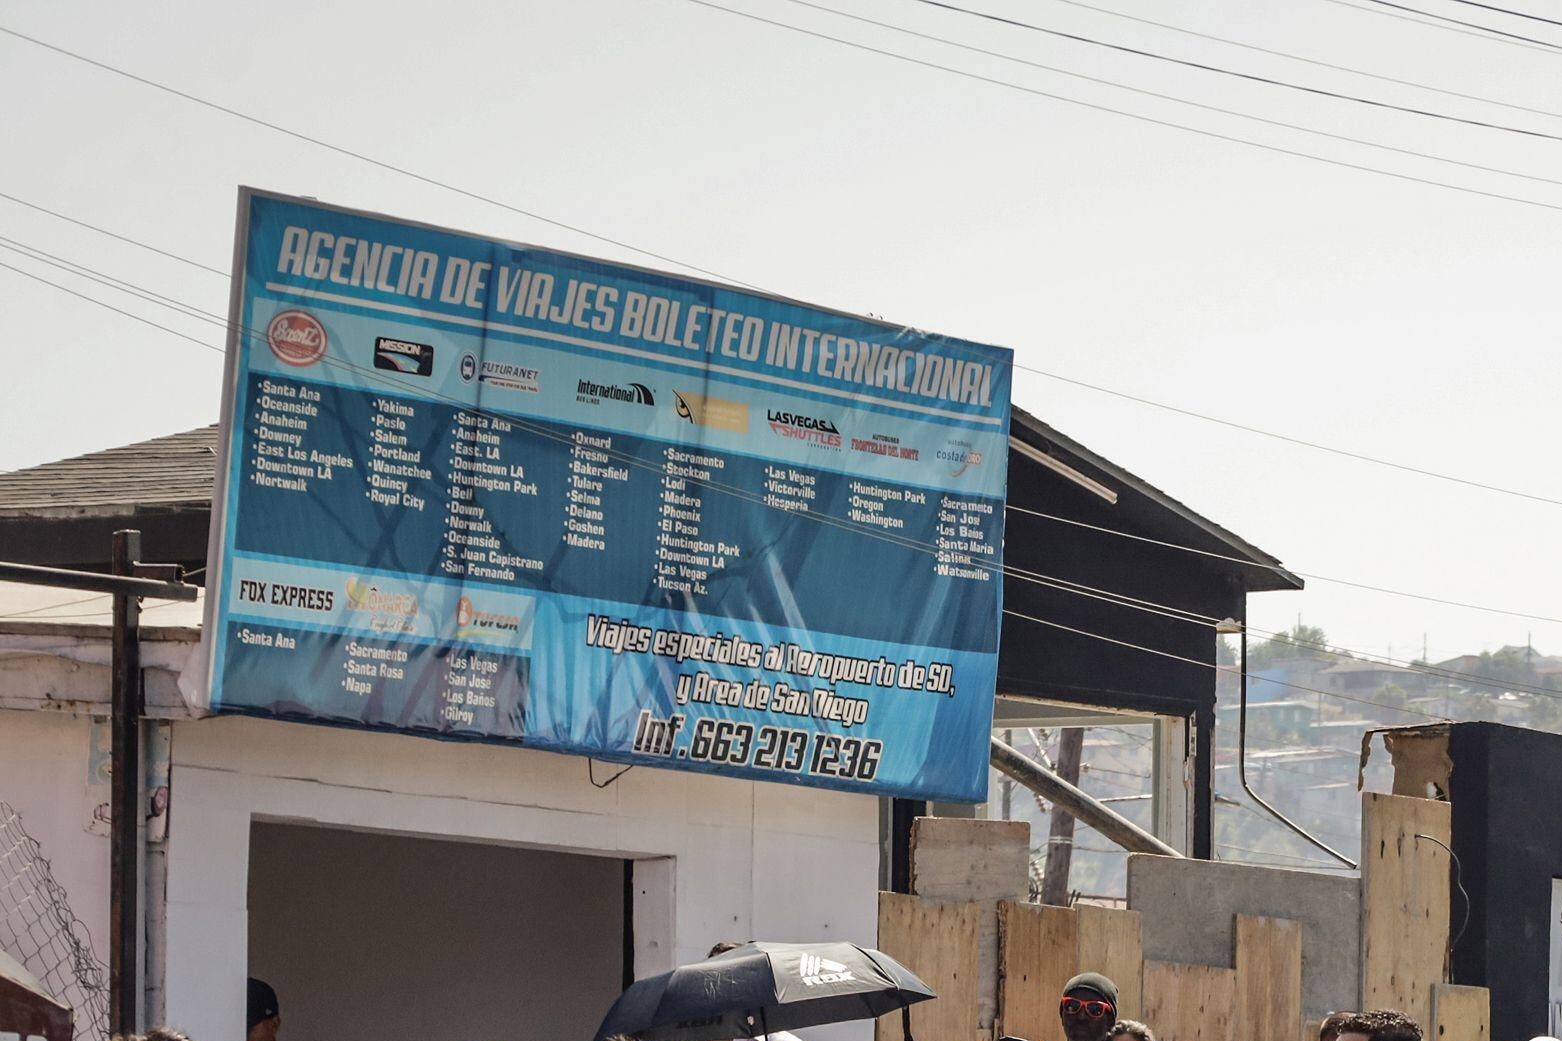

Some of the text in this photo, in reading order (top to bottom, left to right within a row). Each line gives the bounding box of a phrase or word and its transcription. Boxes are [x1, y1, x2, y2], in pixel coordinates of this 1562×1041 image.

[277, 225, 992, 408] AGENCIA DE VIAJES BOLETEO INTERNACIONAL
[379, 339, 421, 354] MISSION
[481, 362, 538, 380] FUTURANET
[262, 380, 320, 401] Santa Ana
[577, 379, 635, 403] International
[262, 396, 318, 416] Oceanside
[377, 399, 414, 416] Yakima
[260, 411, 308, 430] Anaheim
[457, 412, 511, 432] Santa Ana
[259, 426, 302, 447] Downey
[375, 429, 407, 446] Salem
[456, 427, 500, 445] Anaheim
[576, 432, 612, 449] Oxnard
[782, 426, 841, 447] SHUTTLES
[258, 442, 354, 468] East Los Angeles
[374, 444, 421, 463] Portland
[486, 446, 500, 460] LA
[574, 446, 608, 463] Fresno
[668, 448, 724, 468] Sacramento
[256, 456, 332, 480] Downtown LA
[373, 459, 432, 480] Wanatchee
[454, 456, 524, 478] Downtown LA
[573, 460, 628, 480] Bakersfield
[666, 462, 710, 480] Stockton
[769, 466, 816, 486] Las Vegas
[256, 472, 308, 492] Nortwalk
[372, 474, 408, 493] Quincy
[453, 471, 538, 496] Huntington Park
[572, 475, 603, 491] Tulare
[666, 476, 686, 491] Lodi
[768, 480, 816, 500] Victorville
[370, 490, 425, 511] Royal City
[452, 486, 472, 500] Bell
[570, 490, 600, 506] Selma
[664, 491, 701, 507] Madera
[853, 481, 926, 504] Huntington Park
[451, 500, 484, 519] Downy
[570, 504, 604, 520] Delano
[768, 494, 808, 512] Hesperia
[852, 496, 884, 512] Oregon
[664, 505, 701, 522] Phoenix
[852, 509, 904, 528] Washington
[941, 510, 956, 523] San
[450, 516, 492, 533] Norwalk
[568, 519, 604, 536] Goshen
[662, 520, 698, 536] El Paso
[940, 524, 955, 536] Los
[448, 530, 500, 549] Oceanside
[567, 534, 606, 550] Madera
[662, 534, 740, 557] Huntington Park
[940, 537, 969, 551] Santa
[447, 545, 544, 570] S. Juan Capistrano
[660, 548, 725, 569] Downtown LA
[446, 560, 515, 580] San Fernando
[658, 562, 707, 581] Las Vegas
[658, 576, 708, 595] Tucson Az.
[240, 580, 334, 611] FOX EXPRESS
[242, 628, 296, 650] Santa Ana
[349, 642, 408, 662] Sacramento
[586, 614, 956, 697] Viajes especiales al Aeropuerto de SD,
[348, 660, 404, 680] Santa Rosa
[450, 654, 498, 674] Las Vegas
[346, 676, 372, 696] Napa
[449, 671, 466, 686] San
[446, 688, 464, 704] Los
[676, 674, 692, 705] y
[743, 679, 771, 712] de
[771, 682, 811, 717] San
[811, 688, 870, 728] Diego
[445, 706, 474, 725] Gilroy
[690, 716, 754, 766] 663
[752, 726, 809, 773] 213
[808, 732, 884, 782] 1236
